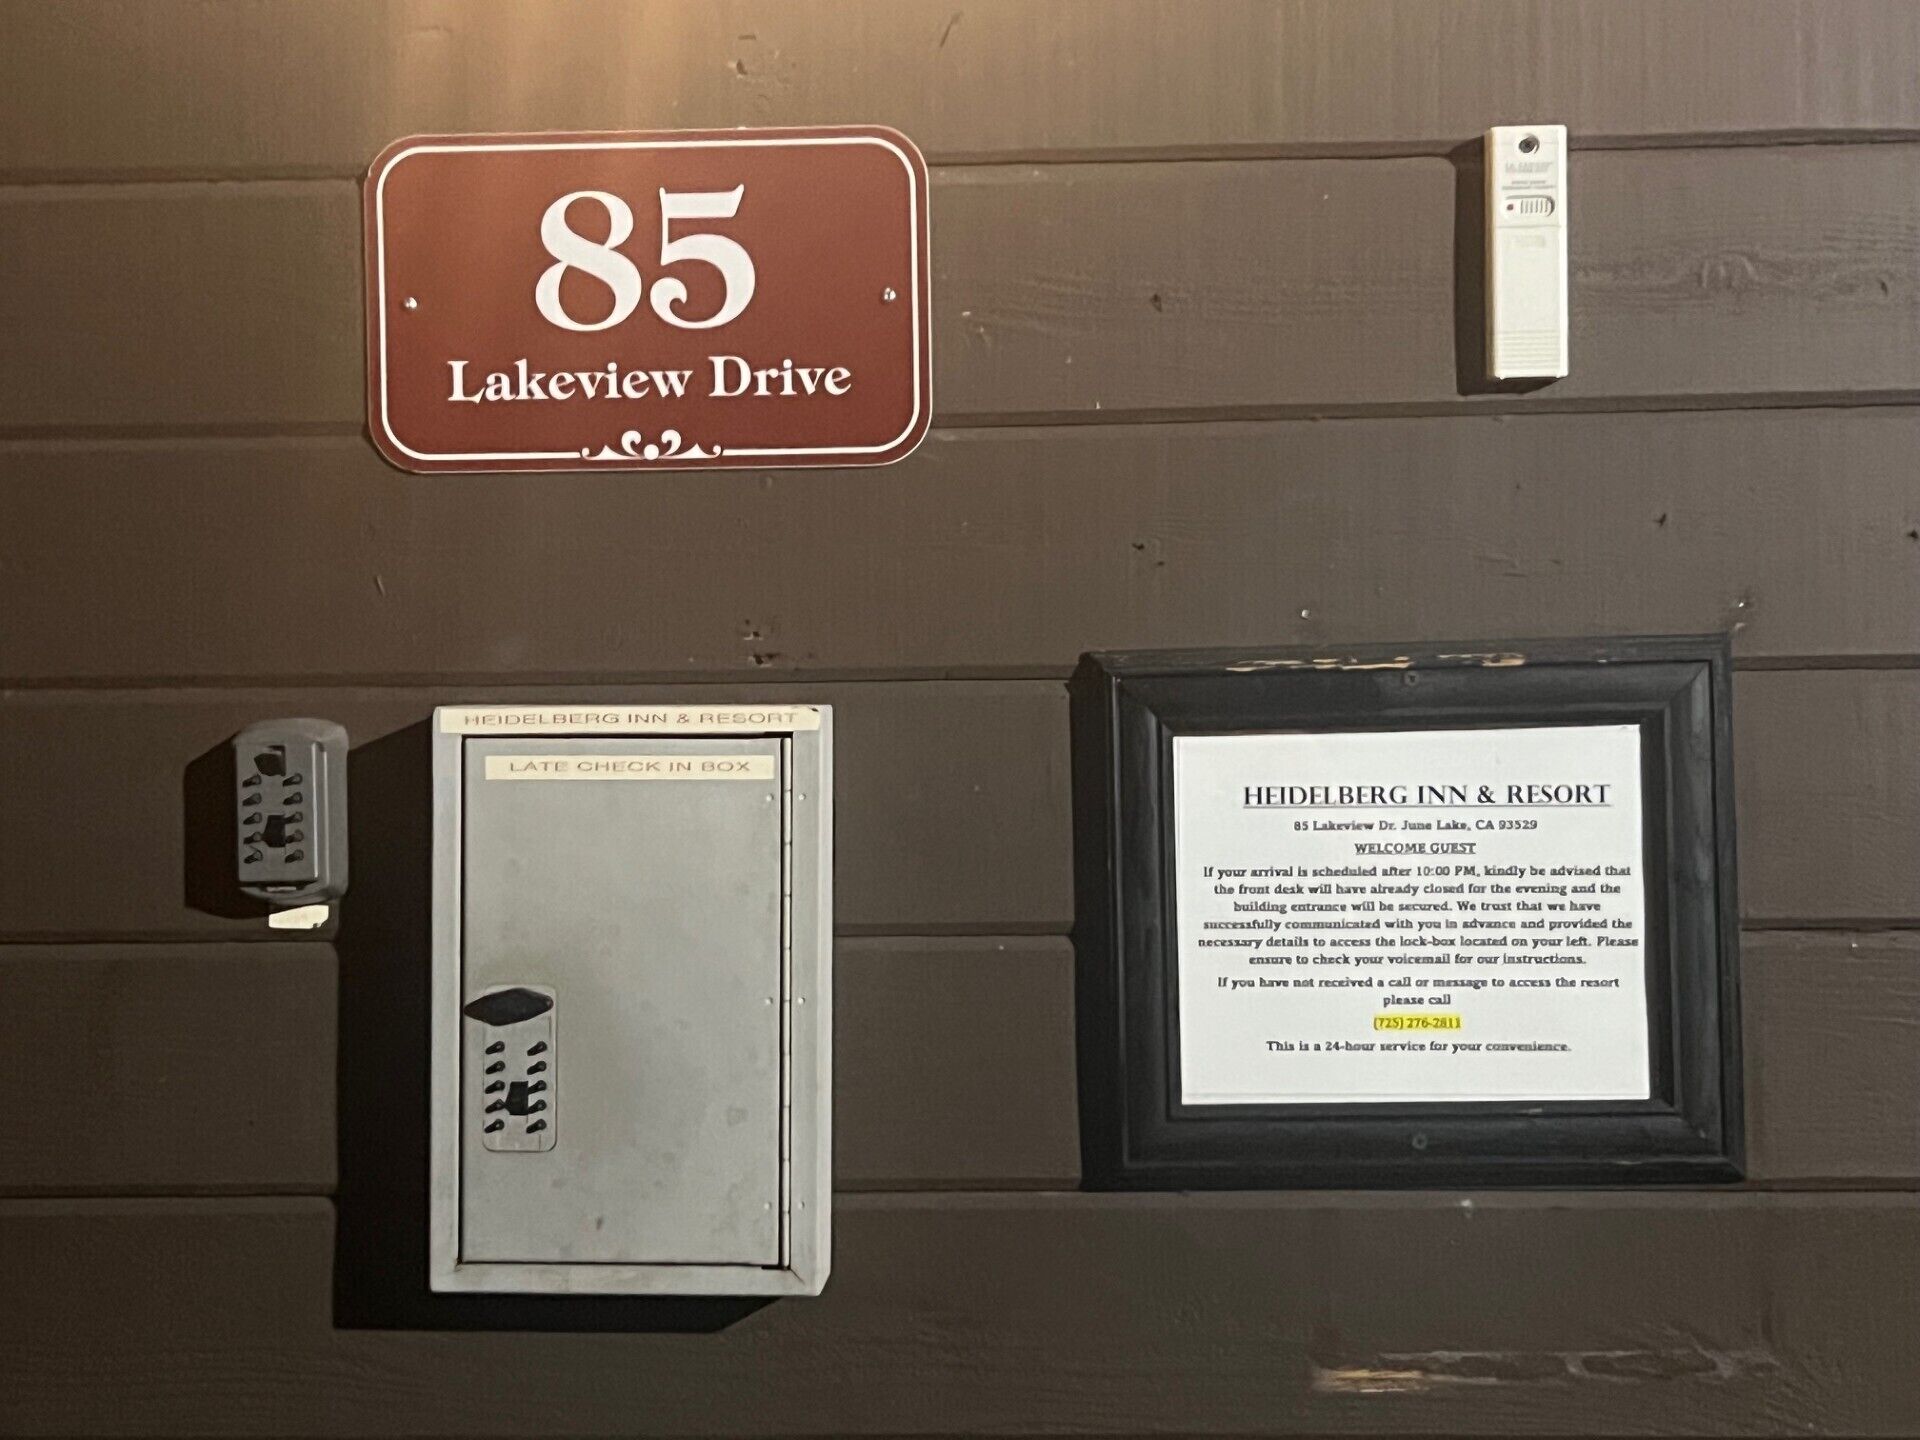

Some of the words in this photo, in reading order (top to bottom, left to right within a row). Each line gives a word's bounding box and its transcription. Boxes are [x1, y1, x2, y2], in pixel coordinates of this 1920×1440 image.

[535, 183, 756, 332] 85
[447, 358, 693, 404] Lakeview
[708, 355, 851, 397] Drive
[465, 713, 619, 726] HEIDELBERG
[628, 713, 667, 724] INN
[677, 713, 690, 724] &
[699, 712, 799, 724] RESORT
[509, 761, 568, 772] LATE
[577, 761, 660, 772] CHECK
[670, 761, 692, 772] IN
[701, 761, 751, 772] BOX
[1244, 786, 1407, 805] HEIDELBERG
[1418, 785, 1467, 804] INN
[1477, 785, 1496, 804] &
[1507, 784, 1611, 804] RESORT
[1294, 821, 1309, 831] 85
[1313, 820, 1374, 831] Lakeview
[1378, 820, 1396, 831] Dr.
[1401, 820, 1431, 830] June
[1437, 820, 1471, 831] Lake,
[1475, 820, 1494, 830] CA
[1498, 820, 1538, 830] 93529
[1354, 843, 1426, 854] WELCOME
[1430, 843, 1476, 854] GUEST
[1203, 867, 1214, 877] If
[1218, 869, 1247, 879] your
[1251, 866, 1293, 877] arrival
[1298, 867, 1308, 877] is
[1312, 866, 1376, 877] scheduled
[1382, 866, 1411, 877] after
[1417, 866, 1450, 876] 10:00
[1484, 866, 1525, 878] kindly
[1530, 866, 1546, 875] be
[1550, 866, 1601, 875] advised
[1605, 866, 1631, 875] that
[1214, 884, 1234, 894] the
[1239, 884, 1269, 894] front
[1275, 884, 1303, 894] desk
[1308, 884, 1332, 894] will
[1336, 884, 1366, 894] have
[1371, 884, 1419, 896] already
[1423, 884, 1464, 893] closed
[1468, 884, 1487, 893] for
[1491, 884, 1511, 893] the
[1516, 884, 1567, 896] evening
[1571, 883, 1595, 893] and
[1601, 883, 1621, 893] the
[1234, 902, 1287, 914] building
[1351, 902, 1375, 911] will
[1379, 902, 1393, 911] be
[1398, 901, 1452, 911] secured.
[1457, 901, 1476, 911] We
[1481, 902, 1512, 911] trust
[1516, 901, 1542, 911] that
[1547, 903, 1566, 911] we
[1570, 901, 1601, 911] have
[1203, 919, 1281, 931] successfully
[1285, 919, 1380, 929] communicated
[1385, 919, 1413, 929] with
[1418, 921, 1441, 931] you
[1445, 919, 1457, 929] in
[1462, 919, 1516, 929] advance
[1521, 919, 1544, 928] and
[1549, 919, 1607, 931] provided
[1612, 919, 1632, 928] the
[1198, 939, 1263, 949] necessary
[1266, 937, 1309, 947] details
[1313, 938, 1326, 947] to
[1330, 939, 1371, 947] access
[1376, 937, 1396, 947] the
[1400, 936, 1455, 946] lock-box
[1460, 936, 1507, 946] located
[1511, 938, 1527, 946] on
[1532, 938, 1563, 949] your
[1566, 936, 1591, 946] left.
[1597, 936, 1639, 946] Please
[1249, 956, 1292, 964] ensure
[1296, 955, 1309, 964] to
[1313, 954, 1350, 964] check
[1355, 956, 1384, 966] your
[1388, 954, 1450, 964] voicemail
[1455, 954, 1473, 964] for
[1477, 956, 1500, 964] our
[1503, 953, 1586, 964] instructions.
[1218, 977, 1228, 987] If
[1232, 979, 1255, 989] you
[1259, 977, 1289, 987] have
[1293, 978, 1314, 987] not
[1318, 977, 1373, 987] received
[1377, 979, 1384, 987] a
[1389, 977, 1411, 987] call
[1415, 979, 1429, 987] or
[1433, 979, 1488, 989] message
[1492, 978, 1505, 987] to
[1509, 978, 1551, 987] access
[1555, 977, 1576, 987] the
[1581, 978, 1619, 987] resort
[1383, 995, 1424, 1007] please
[1429, 995, 1451, 1005] call
[1373, 1017, 1403, 1030] (725)
[1266, 1041, 1294, 1051] This
[1300, 1042, 1309, 1051] is
[1314, 1043, 1321, 1051] a
[1325, 1041, 1375, 1051] 24-hour
[1380, 1041, 1426, 1051] service
[1430, 1041, 1448, 1051] for
[1452, 1043, 1482, 1054] your
[1486, 1041, 1571, 1051] convenience.
